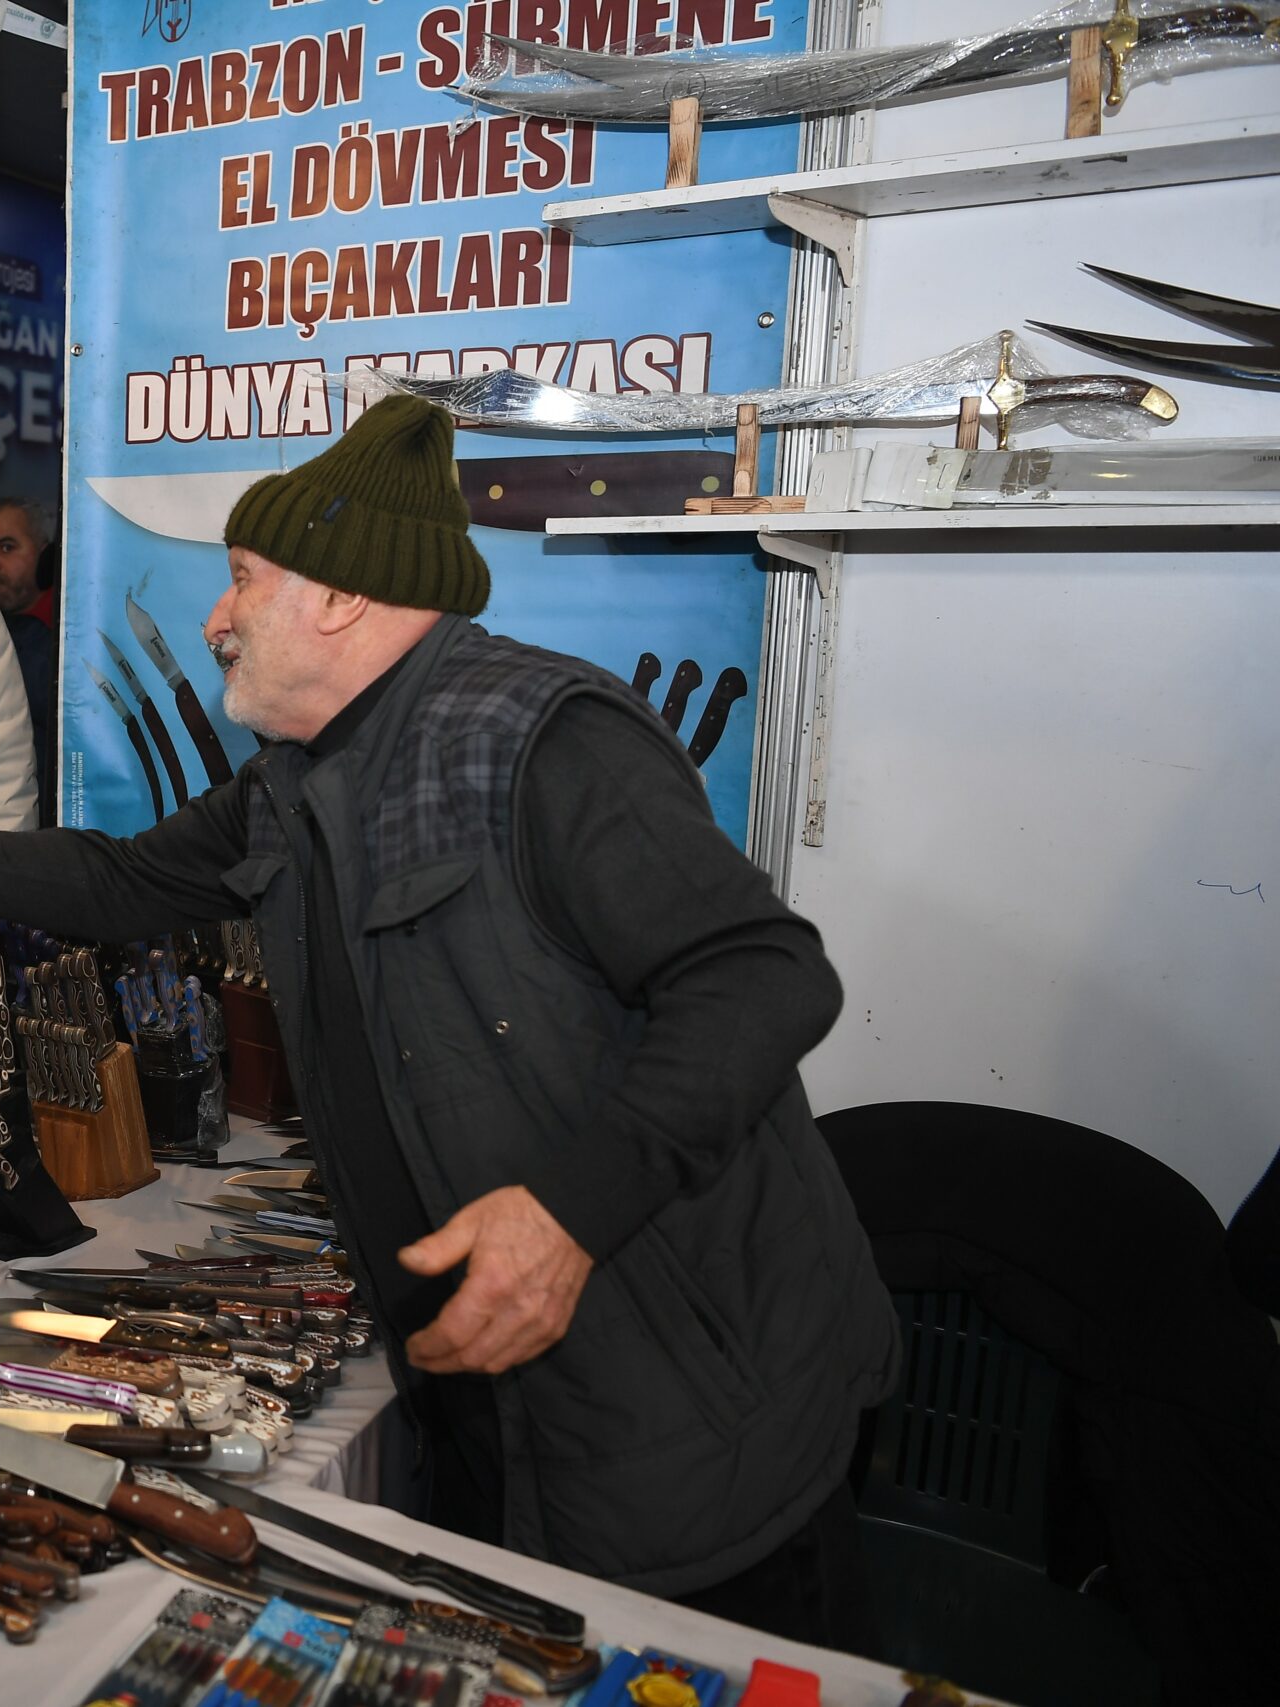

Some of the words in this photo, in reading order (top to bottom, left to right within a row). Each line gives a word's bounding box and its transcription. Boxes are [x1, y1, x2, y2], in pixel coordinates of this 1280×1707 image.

[98, 24, 366, 144] TRABZON
[220, 151, 277, 231] EL
[225, 226, 574, 341] BIÇAKLARI
[125, 354, 331, 444] DÜNYA
